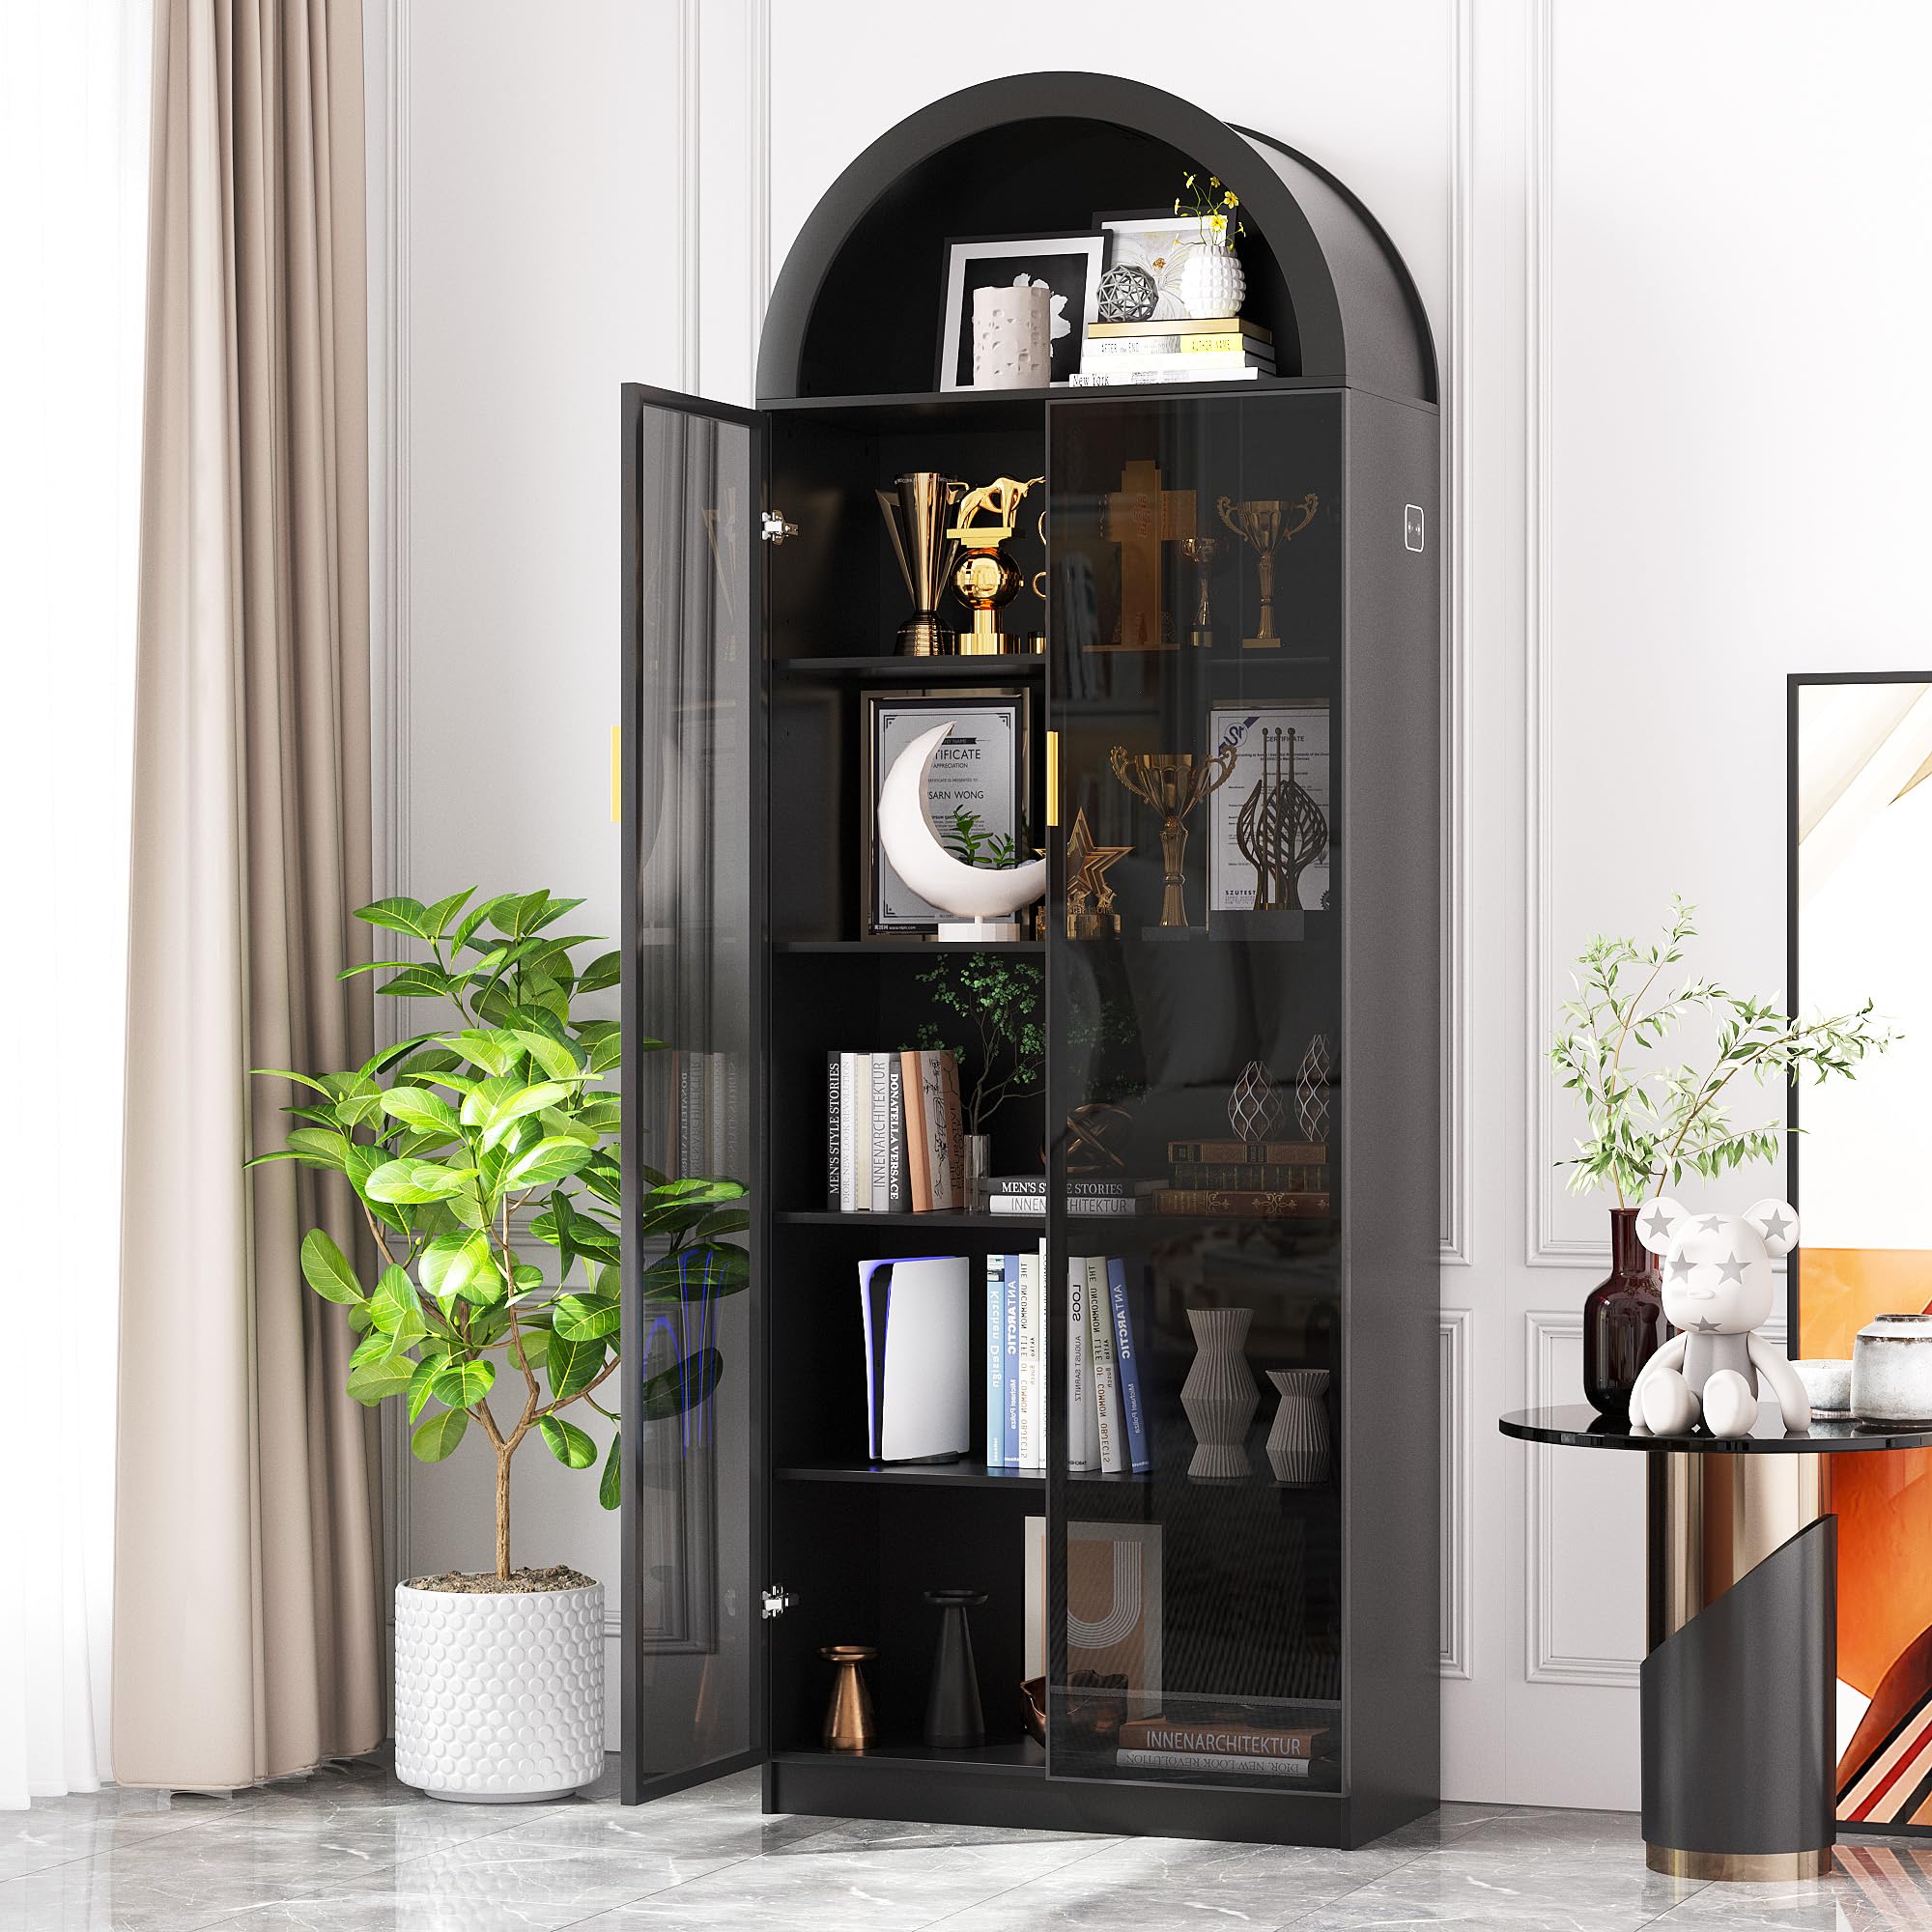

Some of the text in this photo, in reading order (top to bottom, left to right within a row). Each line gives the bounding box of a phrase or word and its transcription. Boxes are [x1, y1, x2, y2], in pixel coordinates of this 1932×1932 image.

[1072, 374, 1110, 387] New York
[935, 749, 981, 760] TIFICATE
[954, 790, 984, 800] WONG
[829, 1063, 839, 1194] MEN'S STYLE STORIES
[873, 1062, 886, 1188] INNENARCHITEKTUR
[890, 1073, 899, 1200] DONATELLA VERSACE
[1002, 1181, 1037, 1193] MEN'S
[1074, 1183, 1123, 1195] STORIES
[1146, 1730, 1300, 1755] INNENARCHITEKTUR
[1126, 1754, 1201, 1767] REVOLUTION
[1203, 1757, 1236, 1770] LOOK
[1236, 1760, 1264, 1772] NEW
